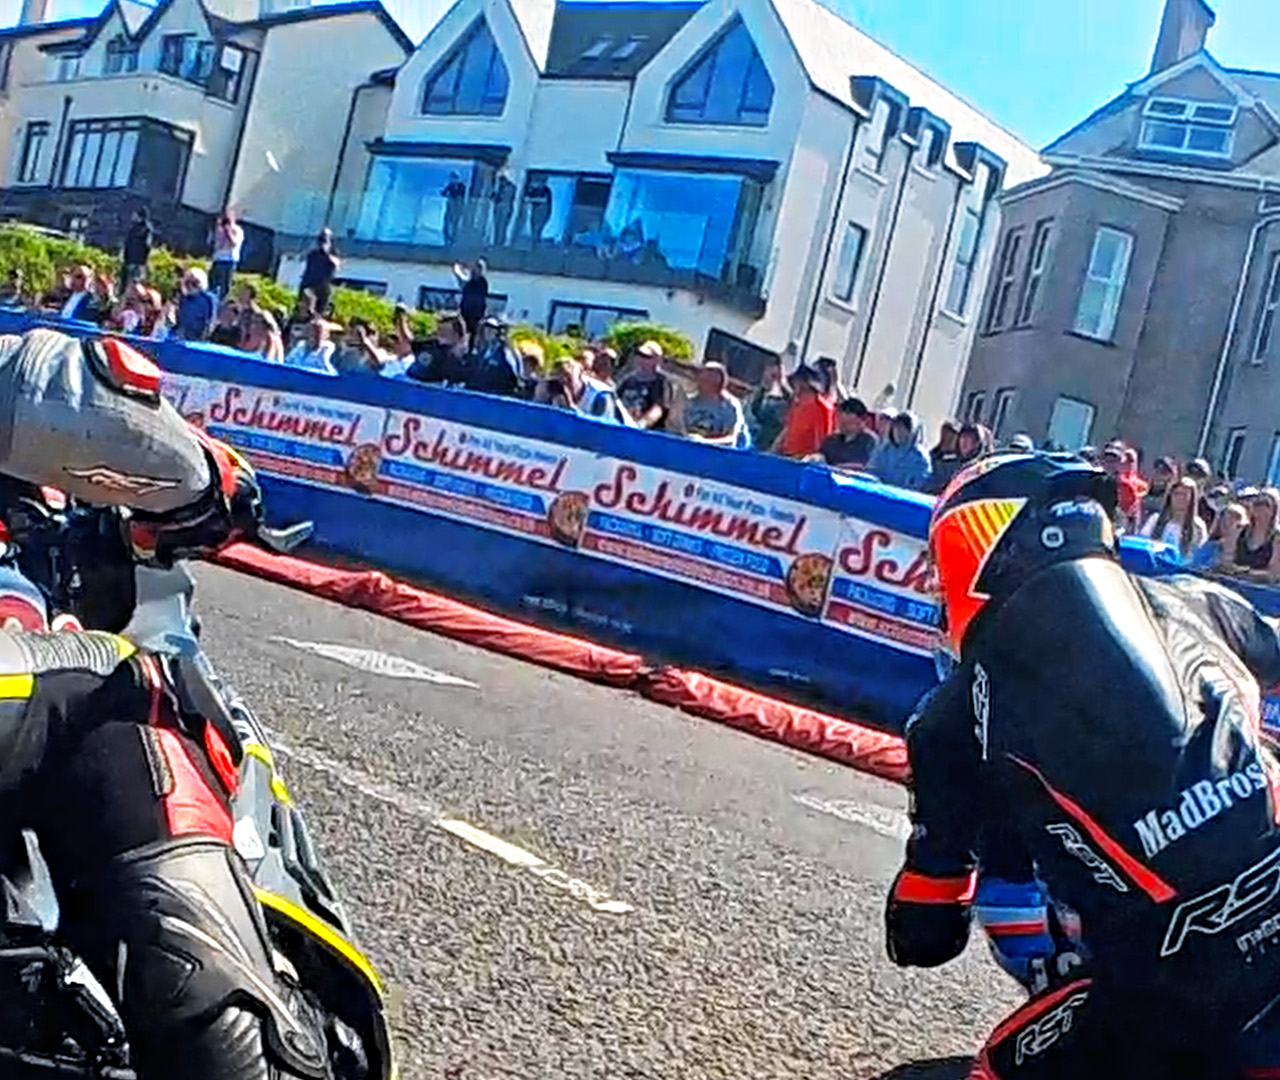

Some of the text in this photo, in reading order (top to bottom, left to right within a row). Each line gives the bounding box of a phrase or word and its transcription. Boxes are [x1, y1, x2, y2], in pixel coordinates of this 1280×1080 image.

[210, 387, 362, 447] Schimmel
[385, 417, 569, 493] Schimmel
[594, 464, 807, 556] Schimmel
[1133, 762, 1269, 860] MadBros
